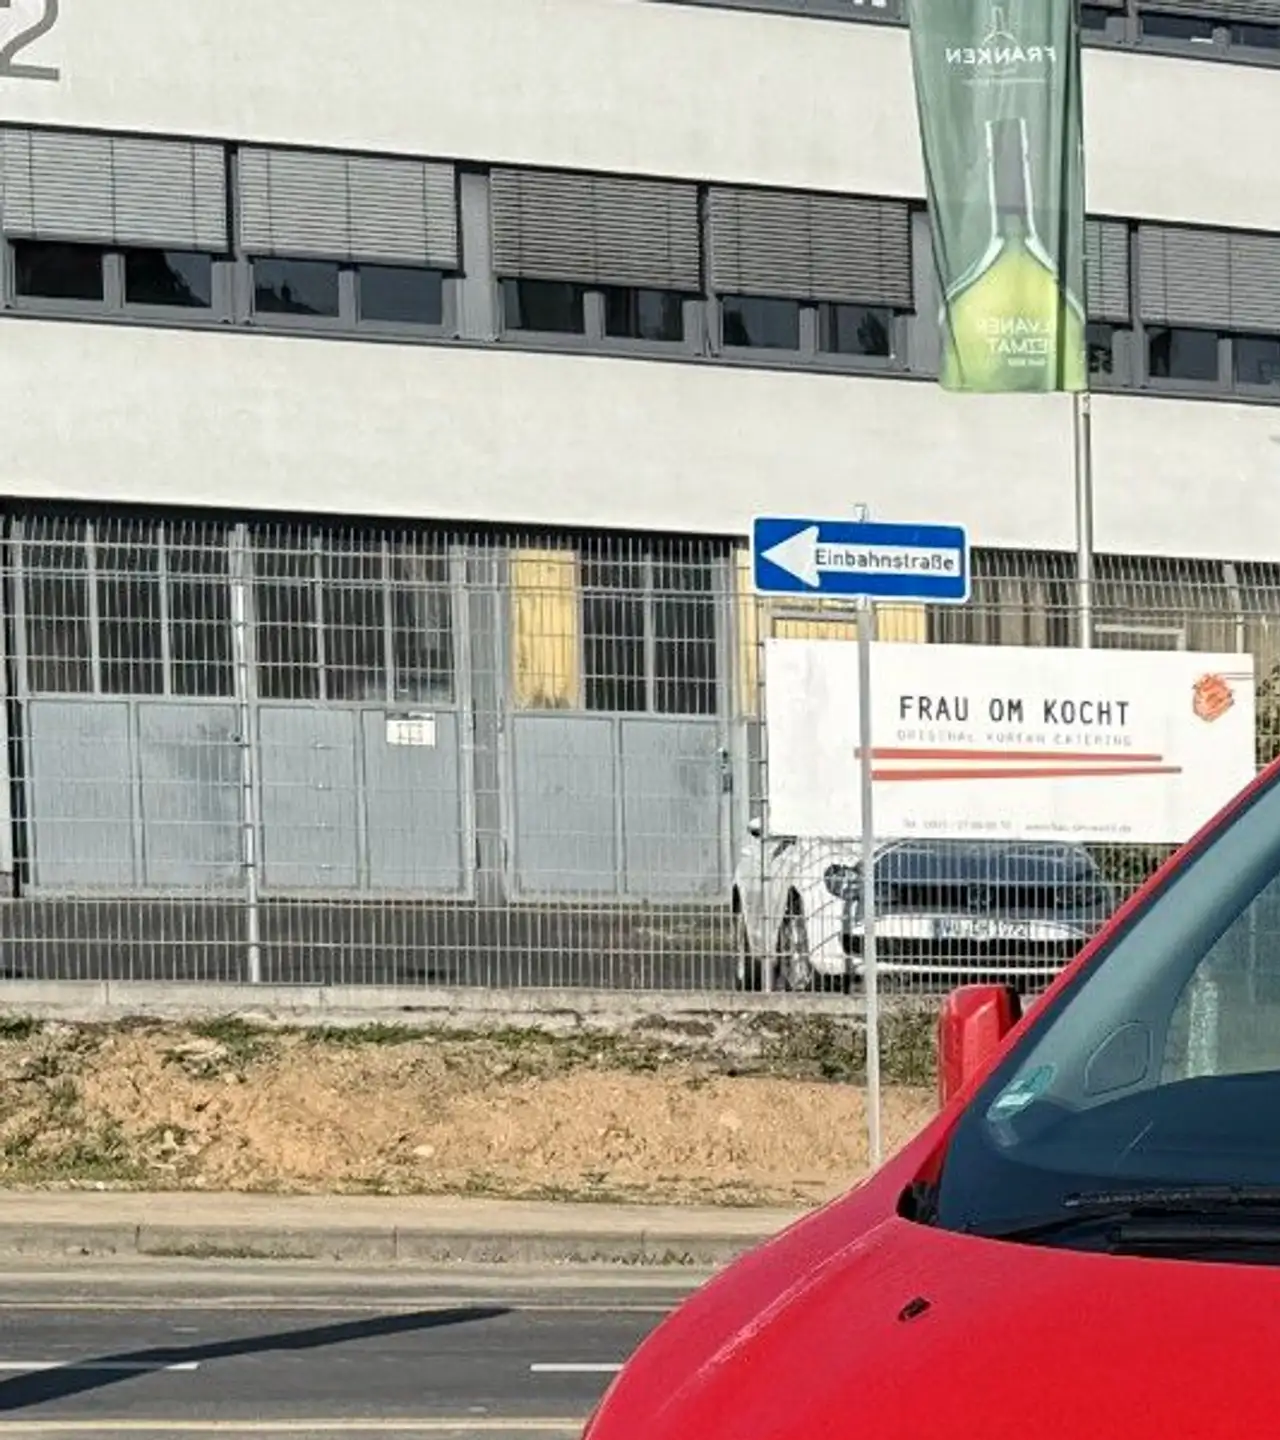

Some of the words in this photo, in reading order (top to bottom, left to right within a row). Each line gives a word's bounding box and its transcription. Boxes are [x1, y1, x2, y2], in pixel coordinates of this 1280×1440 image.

[0, 0, 59, 80] 2
[815, 548, 955, 571] Einbahnstraße
[899, 695, 970, 723] FRAU
[988, 697, 1024, 725] OM
[1043, 699, 1130, 727] KOCHT
